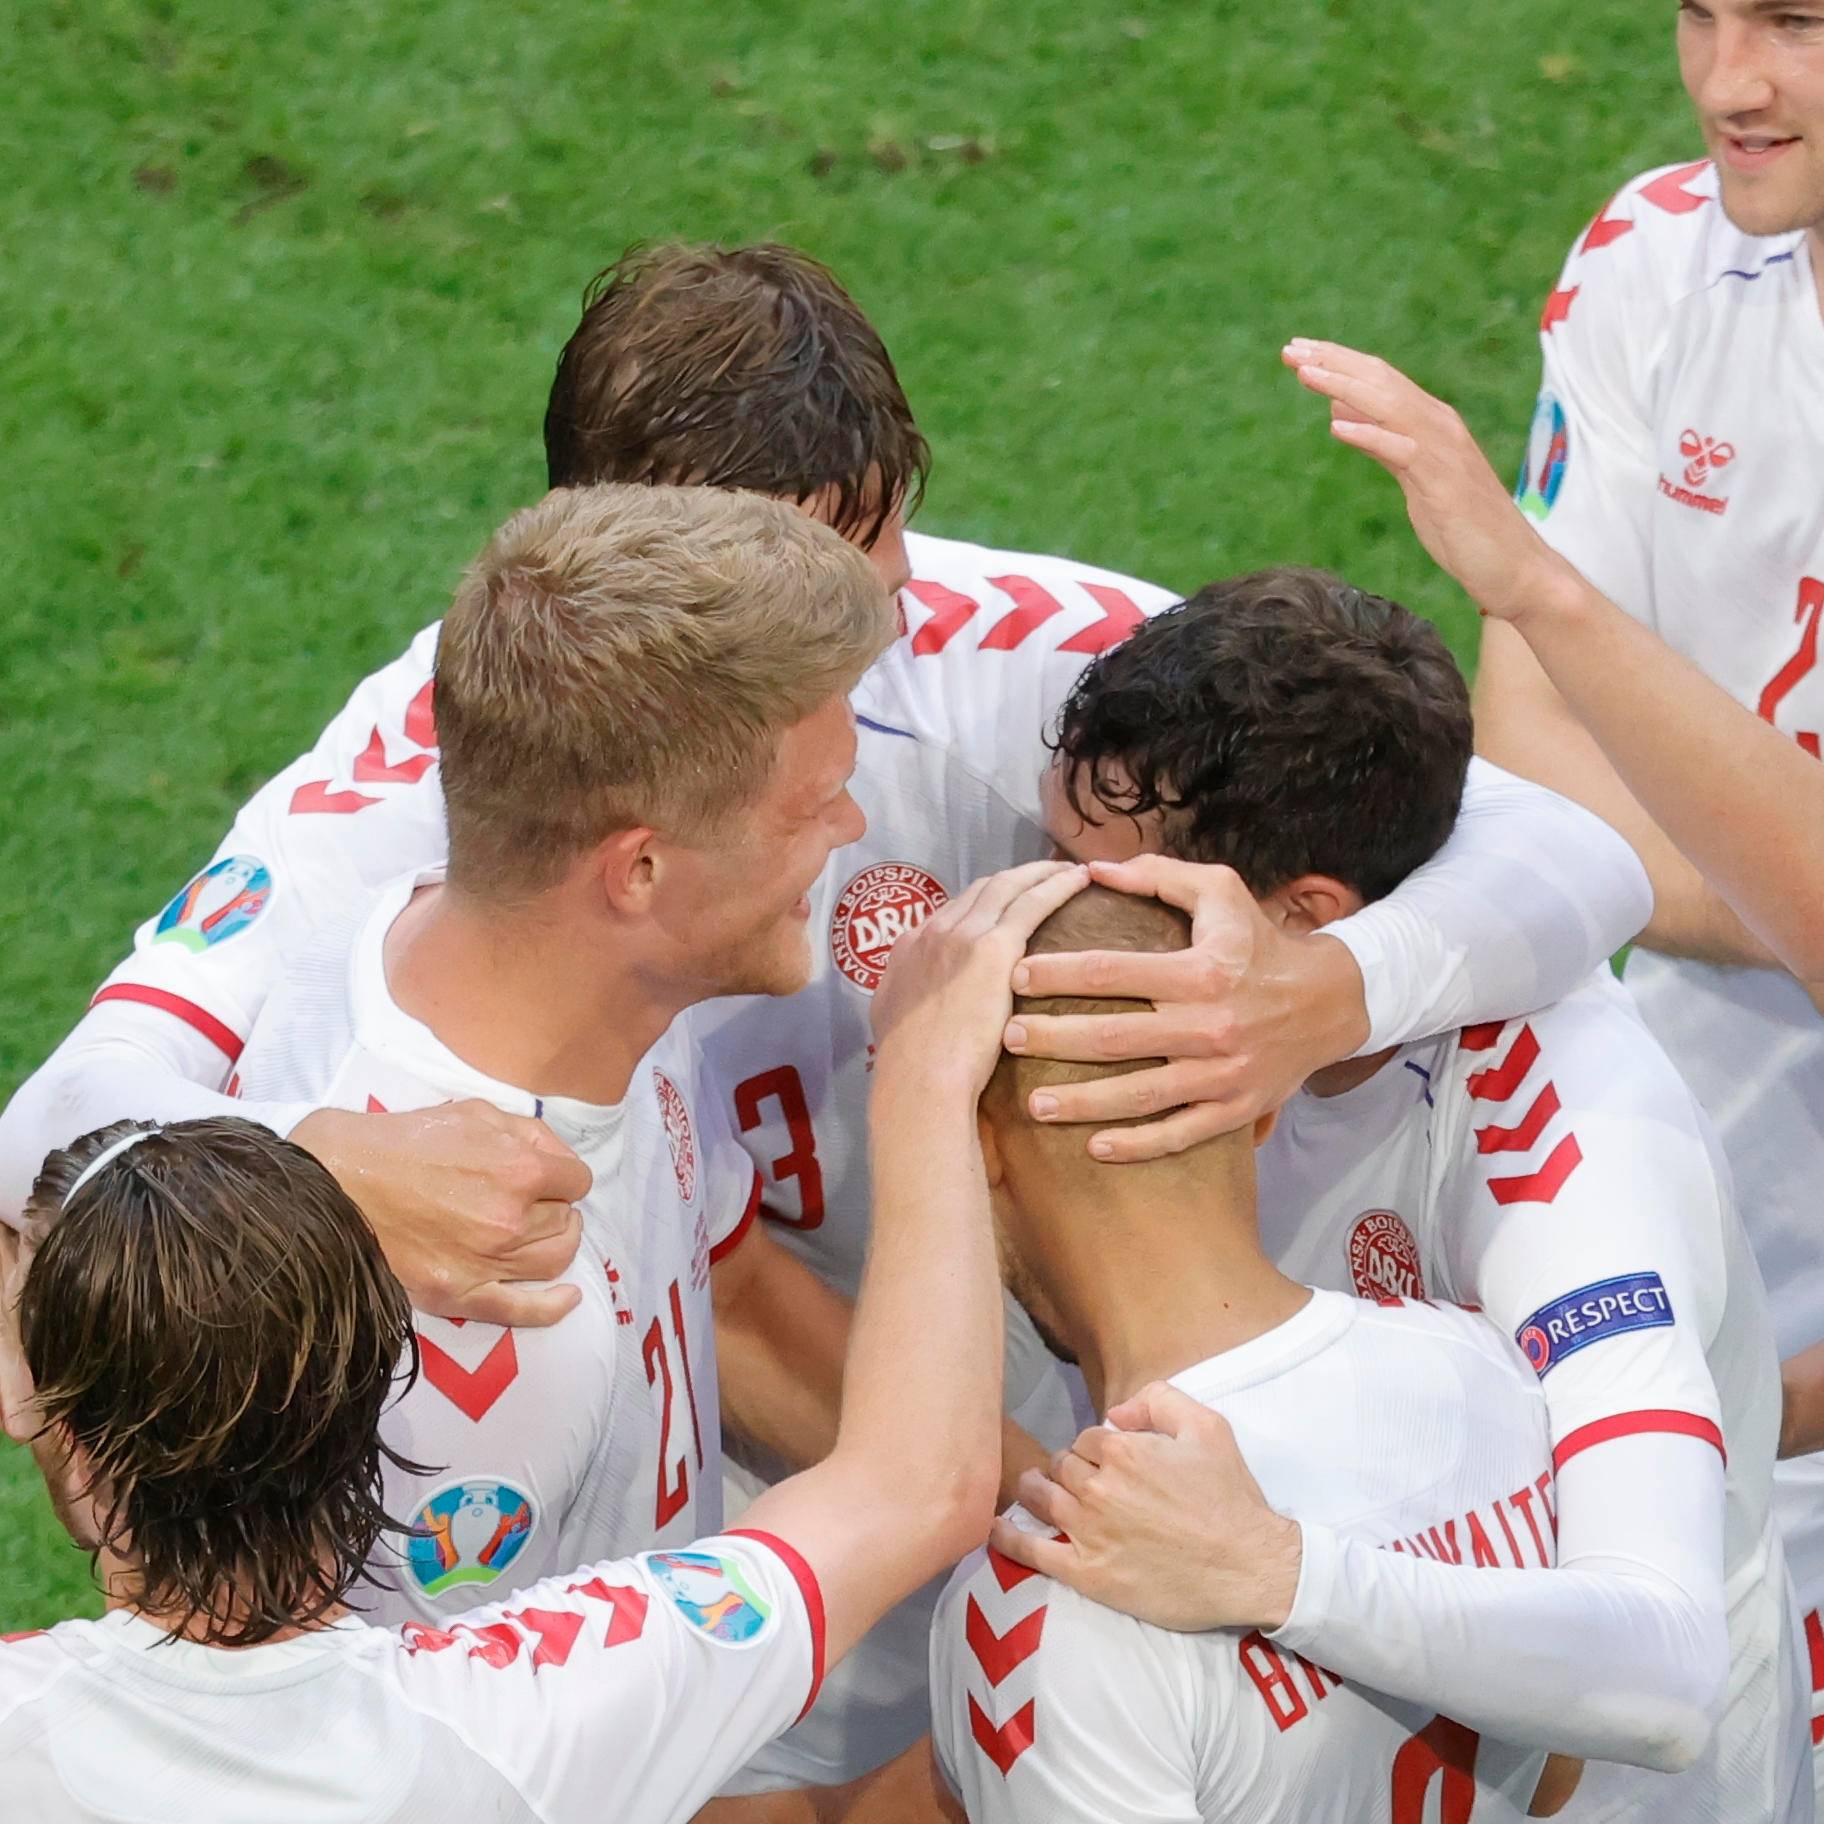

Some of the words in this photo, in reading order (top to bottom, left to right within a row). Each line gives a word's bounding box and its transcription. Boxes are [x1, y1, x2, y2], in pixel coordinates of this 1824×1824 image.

[833, 915, 869, 984] DANSK
[852, 901, 926, 953] DBU
[734, 1065, 825, 1231] 3
[1547, 1286, 1666, 1344] RESPECT
[642, 1277, 704, 1532] 21
